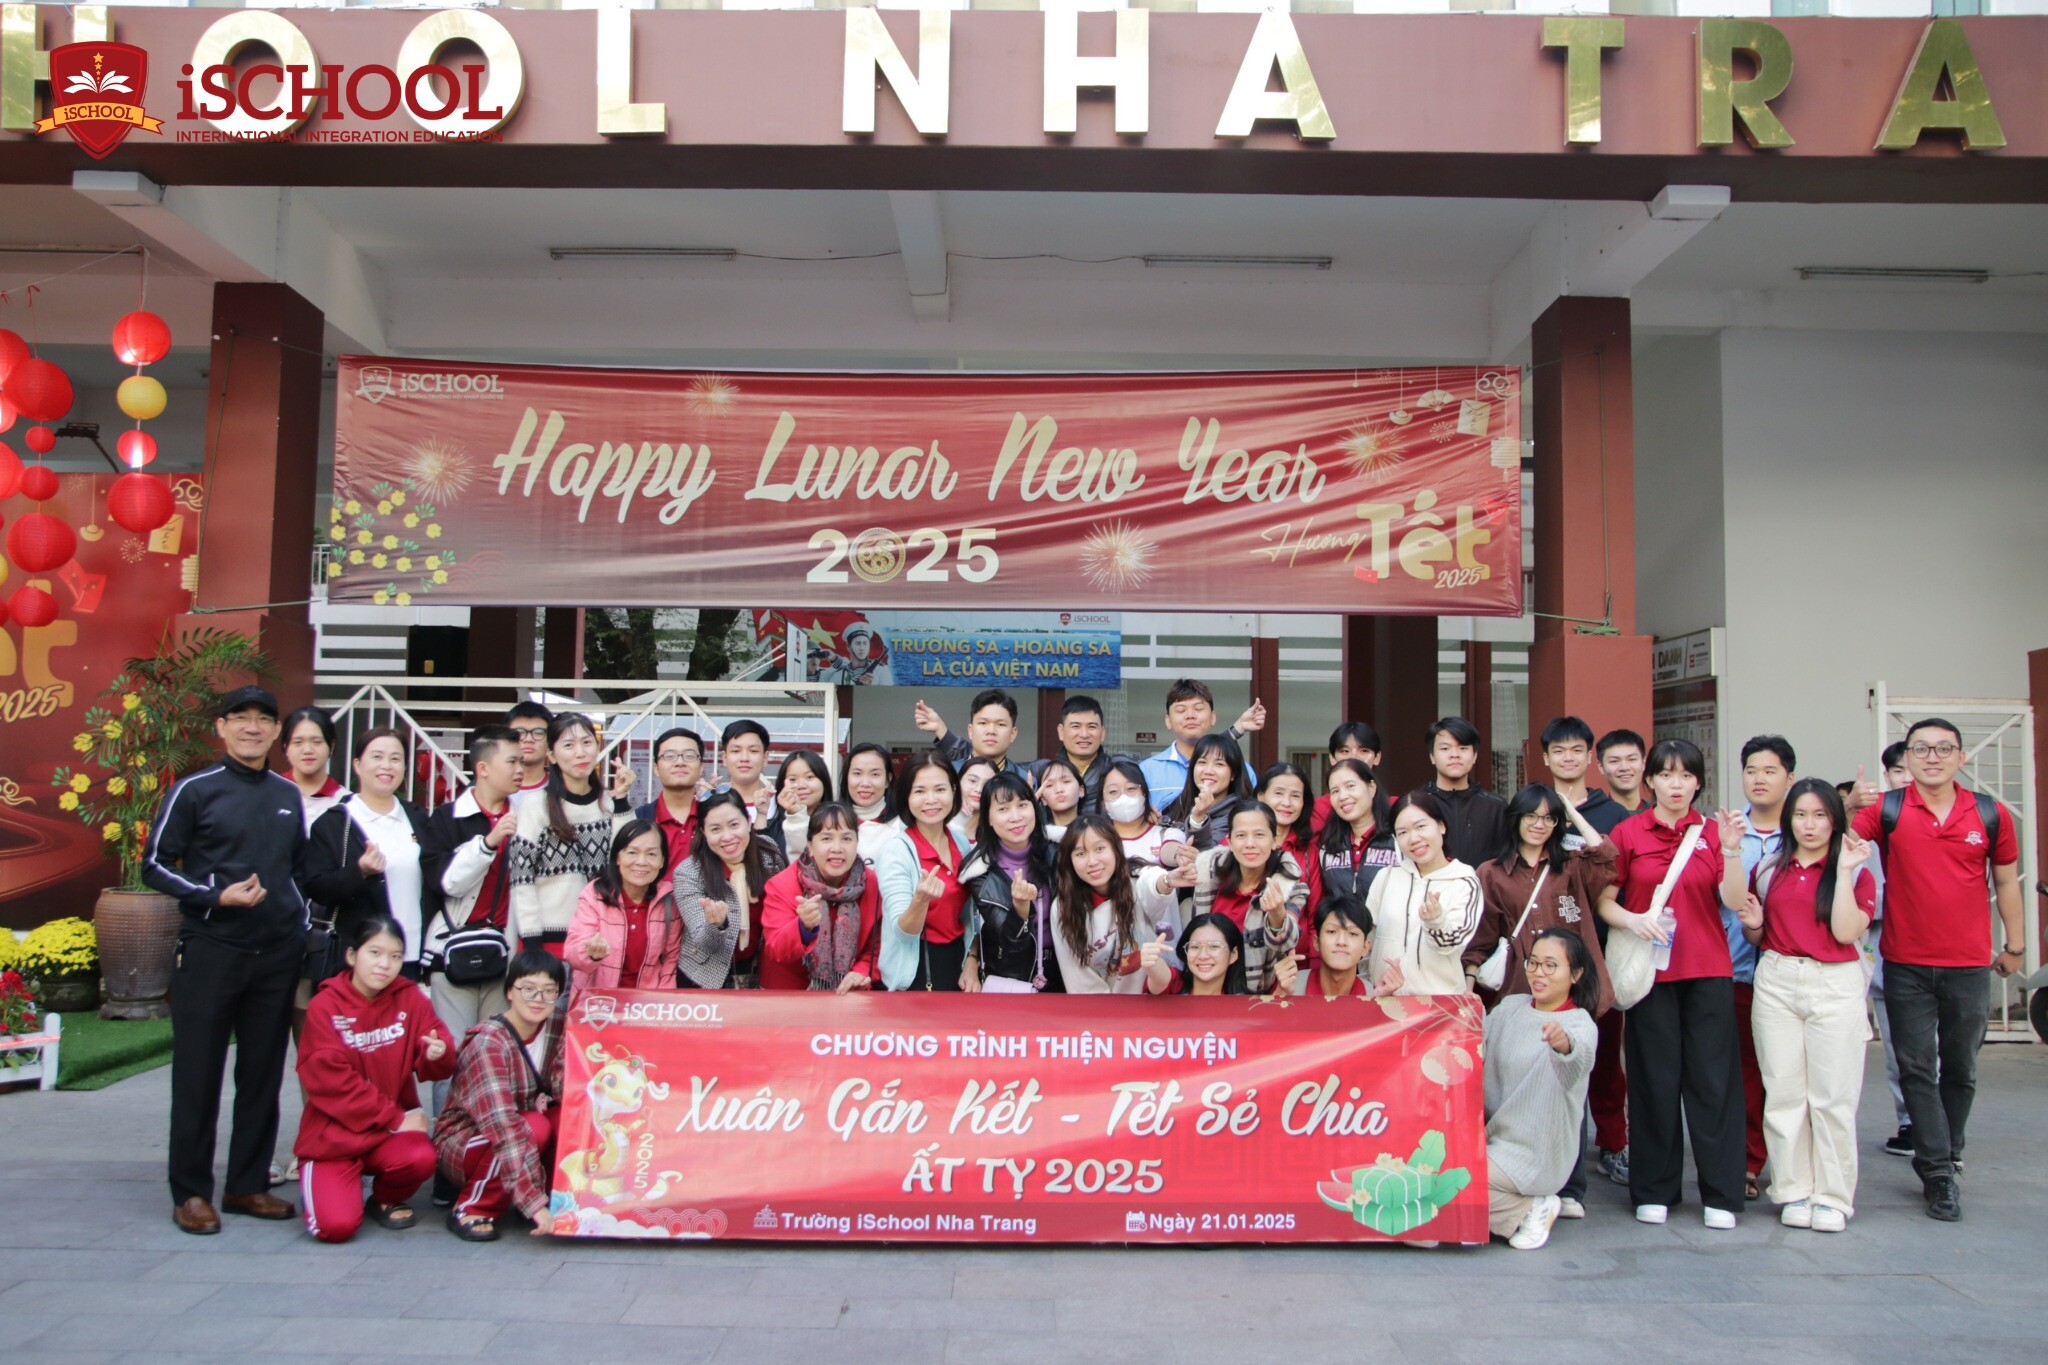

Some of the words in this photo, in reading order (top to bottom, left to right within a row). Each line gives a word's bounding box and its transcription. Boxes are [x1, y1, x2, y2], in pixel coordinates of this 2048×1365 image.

[842, 5, 1337, 142] NHA
[1540, 15, 2008, 151] TRA
[400, 373, 504, 393] iSCHOOL
[493, 406, 716, 525] Happy
[744, 411, 958, 502] Lunar
[988, 412, 1145, 502] New
[1178, 416, 1326, 505] Year
[1356, 489, 1491, 580] Tết
[1434, 566, 1484, 589] 2025
[1074, 615, 1111, 623] iSCHOOL
[891, 635, 970, 655] TRƯỜNG
[975, 639, 1000, 655] SA
[1014, 635, 1083, 656] HOÀNG
[1087, 640, 1113, 656] SA
[922, 656, 946, 677] LÀ
[949, 656, 988, 677] CỦA
[990, 657, 1032, 681] VIỆT
[1035, 661, 1080, 678] NAM
[623, 1002, 723, 1022] iSCHOOL
[811, 1032, 939, 1058] CHƯƠNG
[948, 1031, 1027, 1058] TRÌNH
[1036, 1030, 1114, 1065] THIỆN
[1123, 1032, 1238, 1066] NGUYỆN
[675, 1075, 805, 1133] Xuân
[827, 1077, 929, 1142] Gắn
[948, 1076, 1044, 1136] Kết
[1061, 1113, 1080, 1123] -
[1105, 1078, 1184, 1137] Tết
[1196, 1080, 1261, 1136] Sẻ
[1281, 1073, 1390, 1136] Chia
[633, 1132, 655, 1189] 2025
[901, 1142, 966, 1194] ẤT
[976, 1157, 1037, 1201] TỴ
[1044, 1158, 1164, 1194] 2025
[781, 1210, 852, 1233] Trường
[857, 1212, 931, 1231] iSchool
[936, 1214, 975, 1231] Nha
[980, 1214, 1037, 1235] Trang
[1149, 1213, 1196, 1233] Ngày
[1201, 1213, 1297, 1230] 21.01.2025
